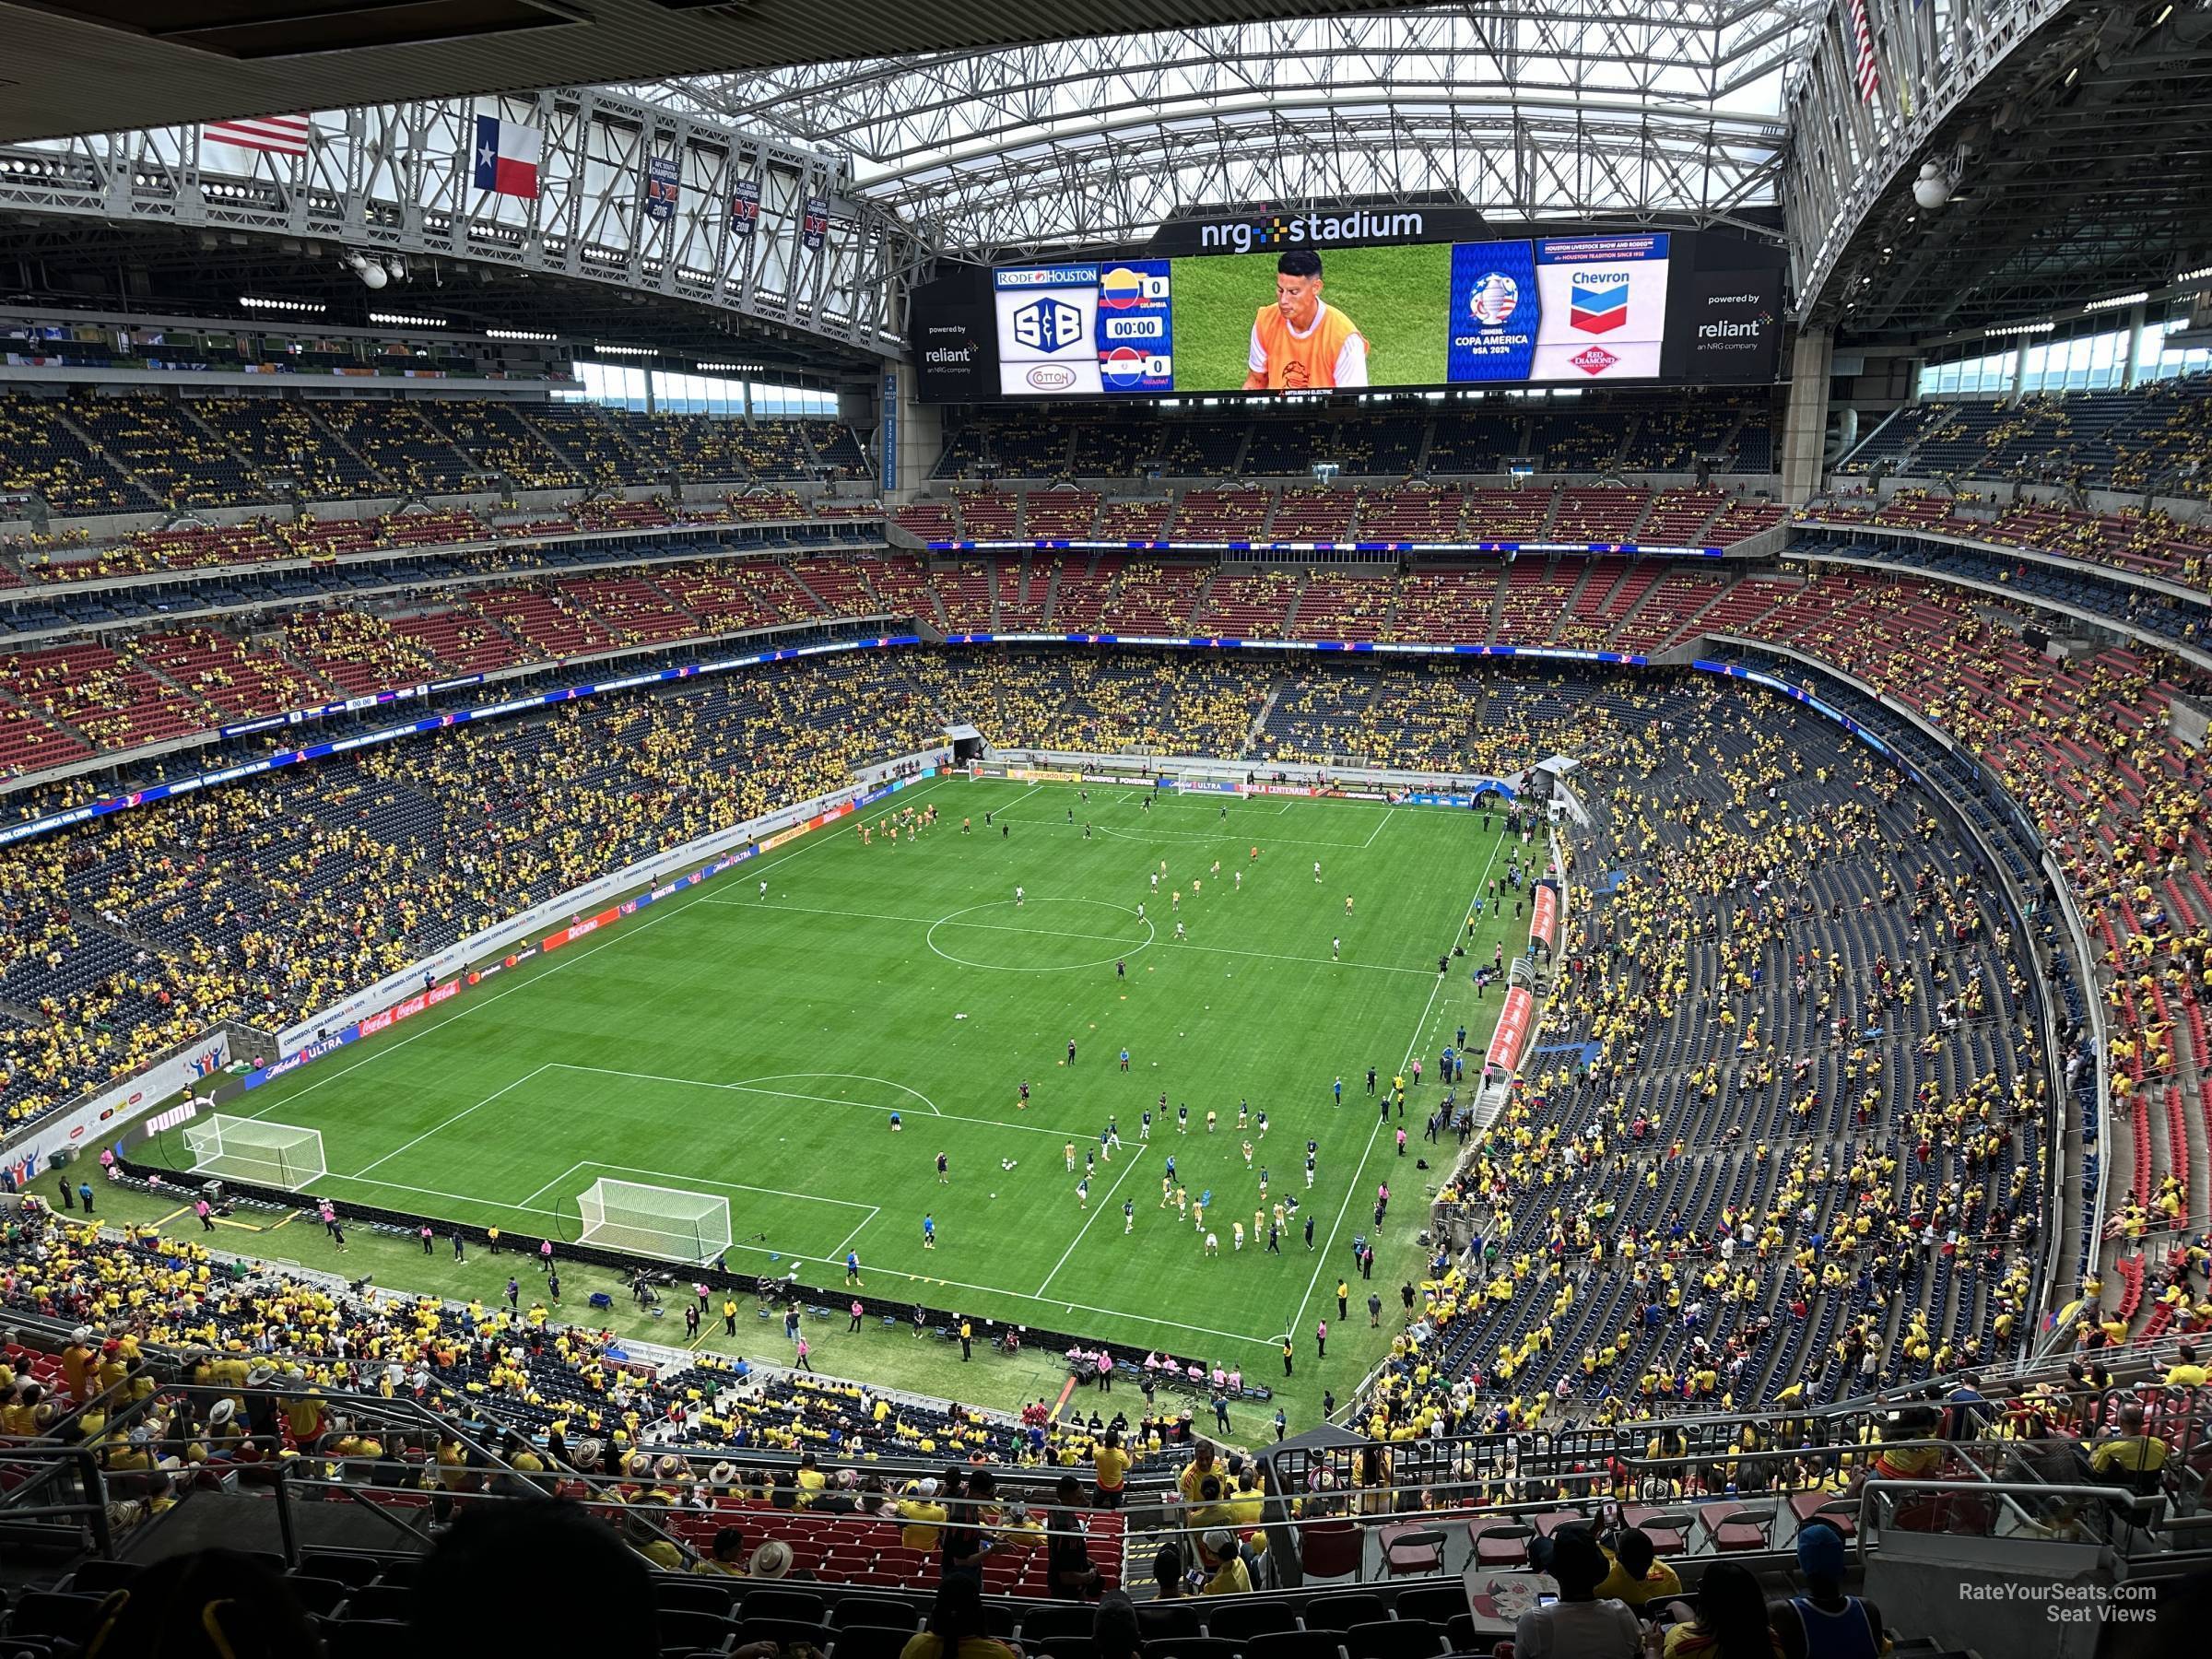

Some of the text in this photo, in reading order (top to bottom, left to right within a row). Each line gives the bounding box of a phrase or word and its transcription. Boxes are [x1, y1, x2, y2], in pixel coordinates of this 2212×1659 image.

[1201, 211, 1422, 253] nrg stadium
[1571, 271, 1630, 284] Chevron
[1151, 281, 1161, 295] 0
[1708, 294, 1759, 305] powered by
[929, 325, 966, 335] powered by
[1114, 321, 1156, 335] 00:00
[1698, 320, 1760, 338] reliant
[1454, 335, 1528, 347] COPA AMERICA
[1707, 342, 1724, 350] NRG
[1724, 343, 1758, 351] company
[925, 344, 971, 362] reliant
[1472, 346, 1510, 355] USA 2024
[1154, 359, 1163, 373] 0
[1575, 357, 1615, 365] DIAMOND
[1032, 371, 1068, 384] COTTON
[1028, 771, 1076, 781] mercado libre
[1198, 782, 1222, 790] ULTRA
[1268, 785, 1312, 796] CENTENARIO
[734, 850, 751, 865] ULTRA
[283, 1027, 312, 1046] CONMEBOL
[312, 1021, 325, 1034] COPA
[324, 1010, 346, 1027] AMERICA
[354, 998, 366, 1010] 2024
[308, 1036, 343, 1059] ULTRA
[146, 1099, 197, 1137] PUMA
